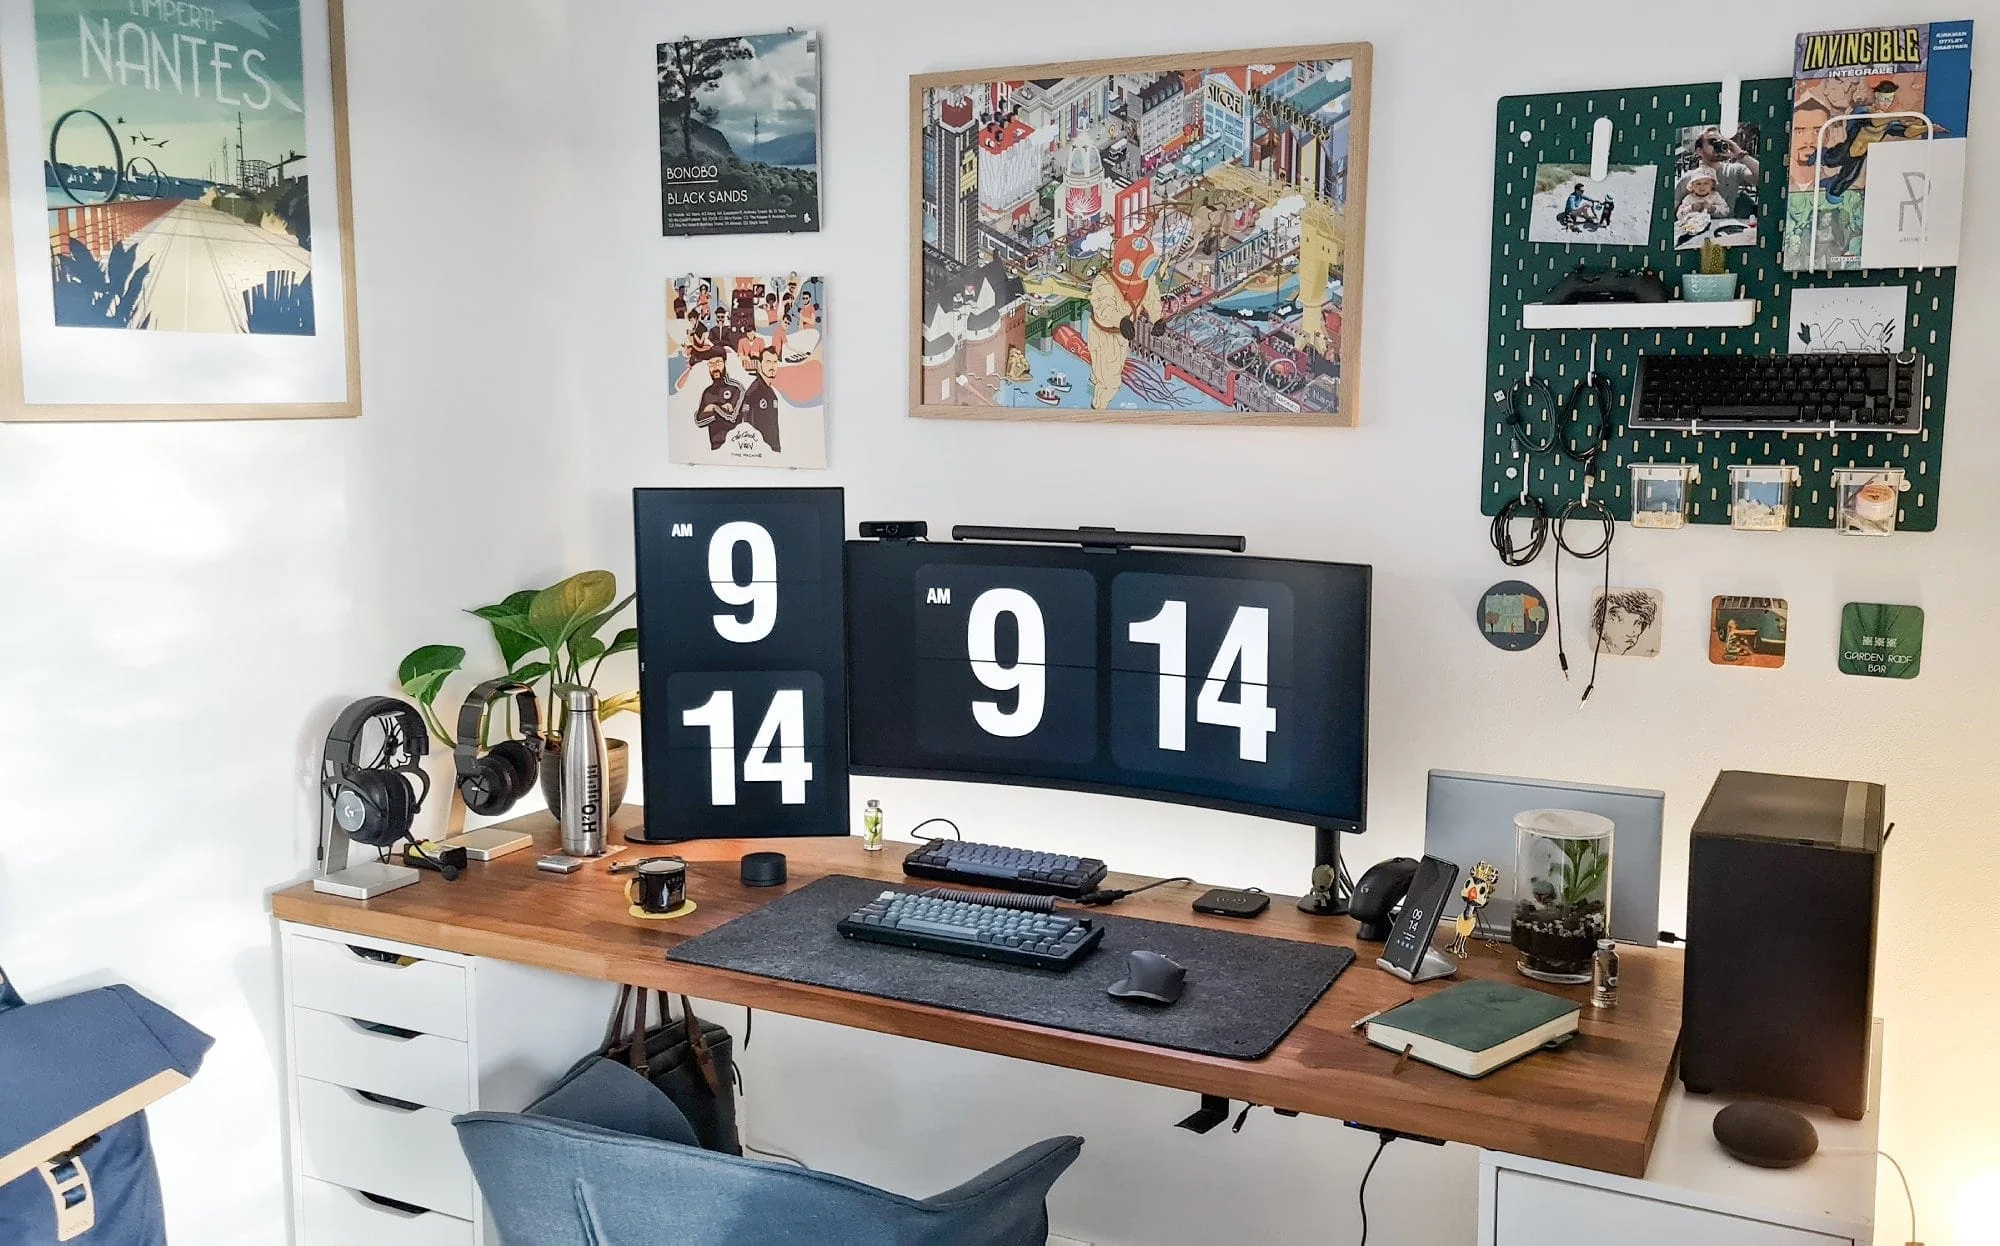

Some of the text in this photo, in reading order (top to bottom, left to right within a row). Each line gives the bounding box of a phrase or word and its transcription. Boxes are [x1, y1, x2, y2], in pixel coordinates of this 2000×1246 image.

[1803, 28, 1921, 71] INVINCIBLE
[79, 14, 271, 110] NANTES
[666, 165, 719, 180] BONOBO
[667, 189, 748, 205] BLACK SANDS
[672, 523, 693, 537] AM
[708, 521, 778, 643] 9
[926, 588, 951, 604] AM
[1844, 651, 1913, 664] GARDEN ROOF
[967, 587, 1277, 763] 9 14
[1867, 664, 1887, 673] BAR
[682, 689, 813, 805] 14
[1412, 908, 1423, 921] 09
[1408, 919, 1419, 932] 14
